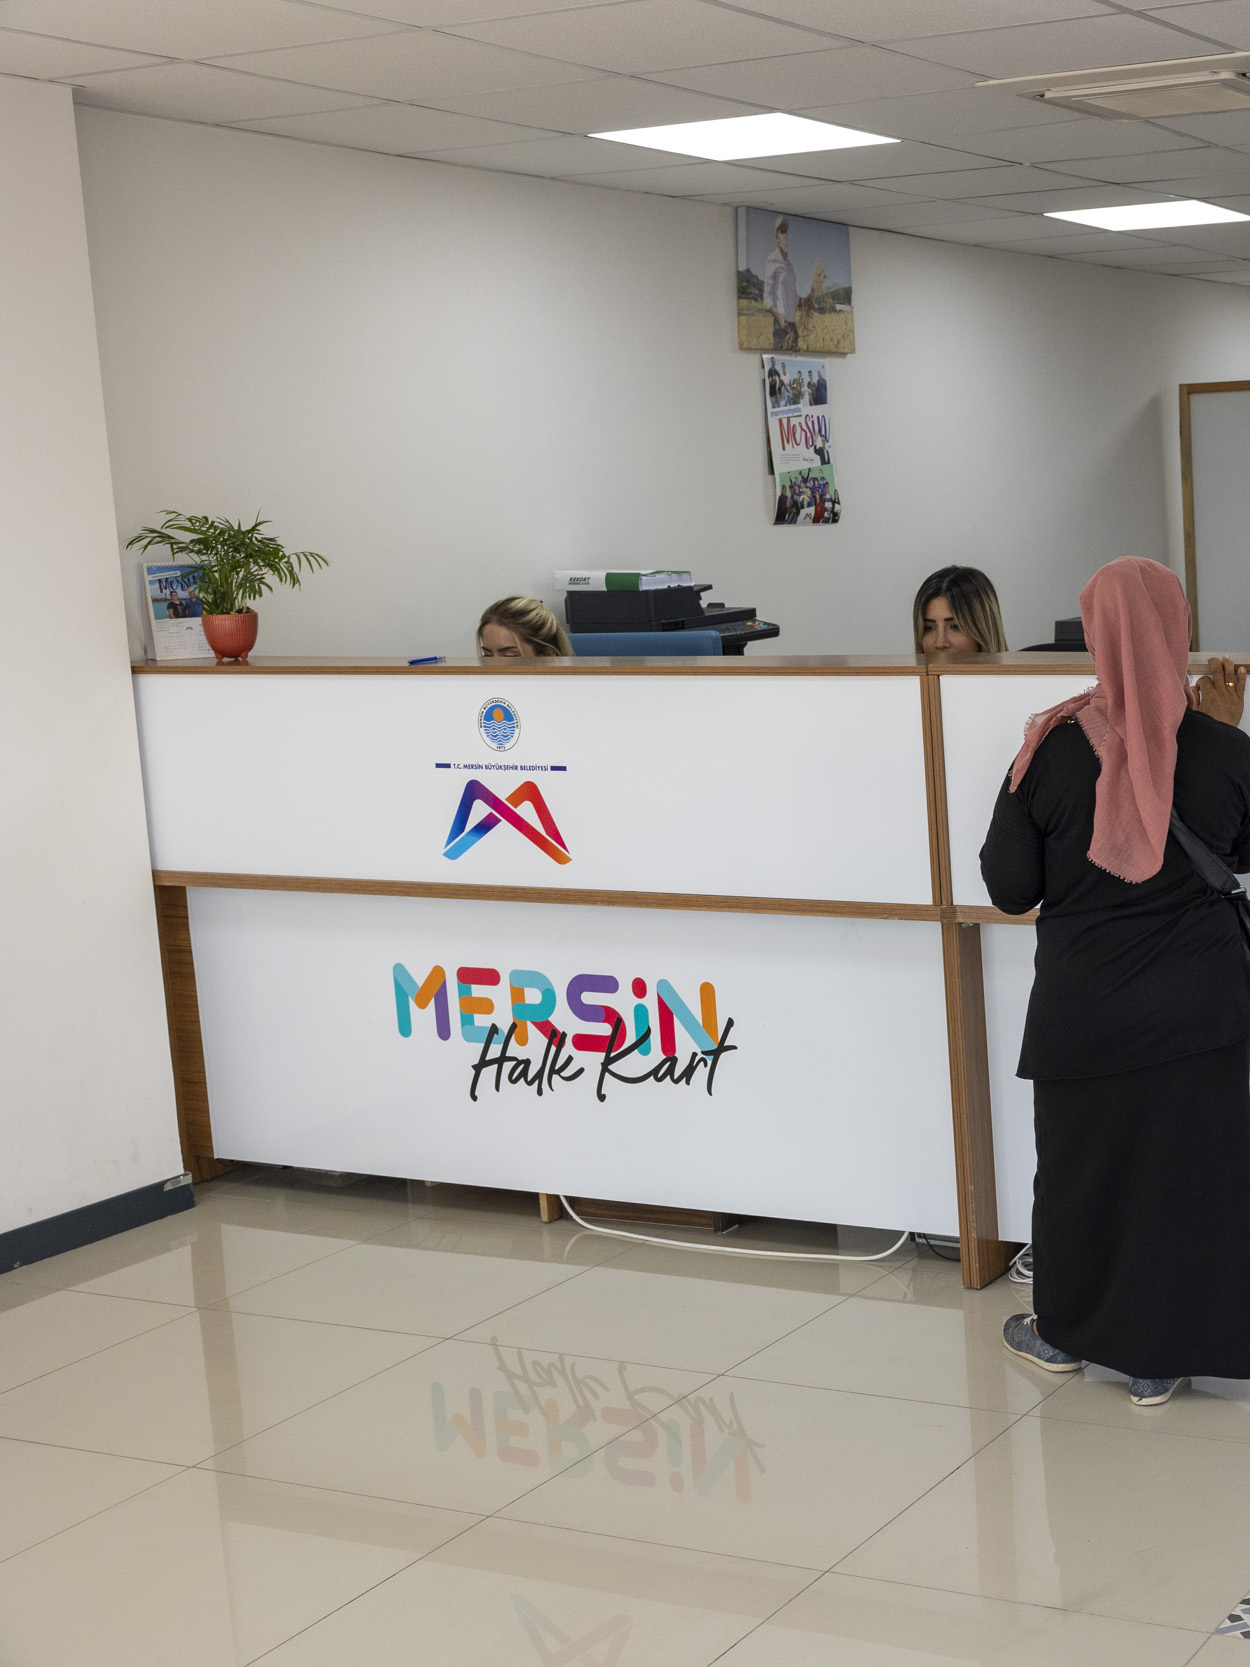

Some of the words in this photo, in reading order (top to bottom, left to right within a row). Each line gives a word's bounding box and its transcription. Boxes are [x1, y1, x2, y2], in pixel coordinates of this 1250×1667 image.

[778, 414, 830, 451] Mersin
[469, 1021, 585, 1102] Halk
[596, 1017, 738, 1102] Kart
